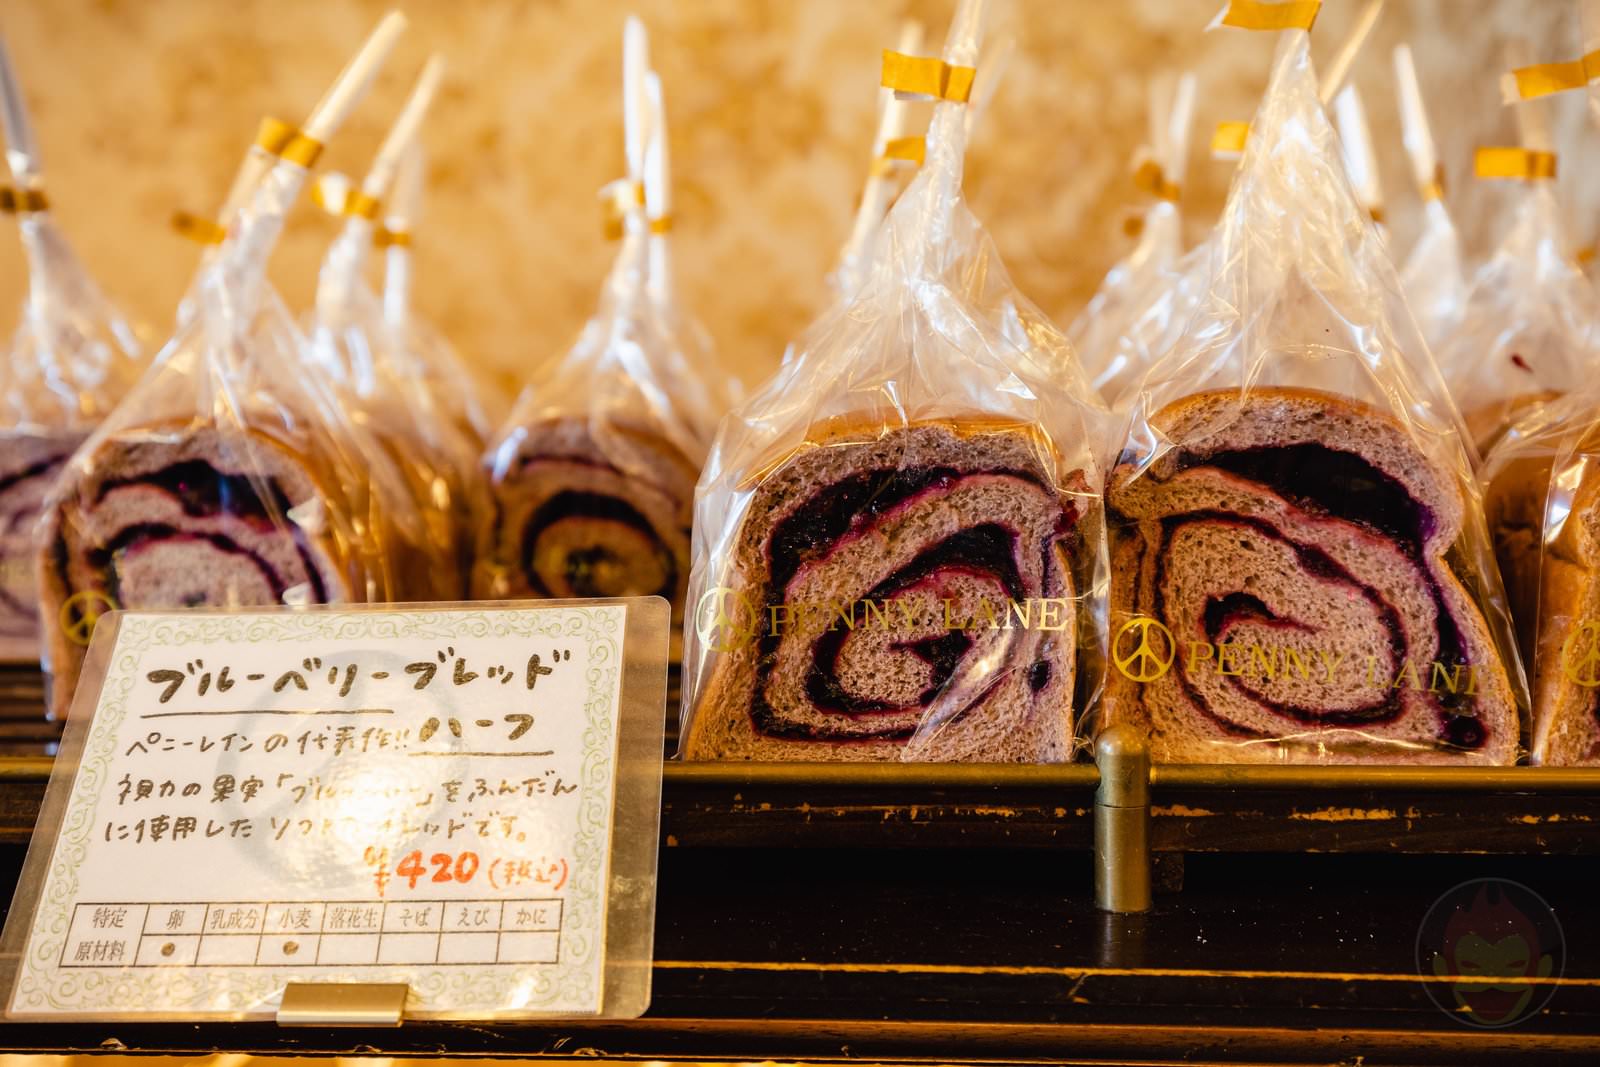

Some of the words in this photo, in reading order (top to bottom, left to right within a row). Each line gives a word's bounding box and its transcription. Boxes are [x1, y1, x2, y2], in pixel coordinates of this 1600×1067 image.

[767, 598, 926, 638] PENNY
[942, 596, 1068, 631] LANE
[147, 647, 571, 703] ブルーベリーブレッド
[1185, 640, 1344, 684] PENNY
[419, 714, 534, 742] ハーフ
[92, 907, 128, 929] 特定
[166, 908, 186, 930] 卵
[210, 908, 261, 930] 乳成分
[279, 907, 312, 929] 小麦
[329, 907, 378, 929] 落花生
[399, 906, 433, 927] そば
[457, 907, 491, 927] えび
[516, 907, 548, 926] かに
[74, 940, 127, 962] 原材料
